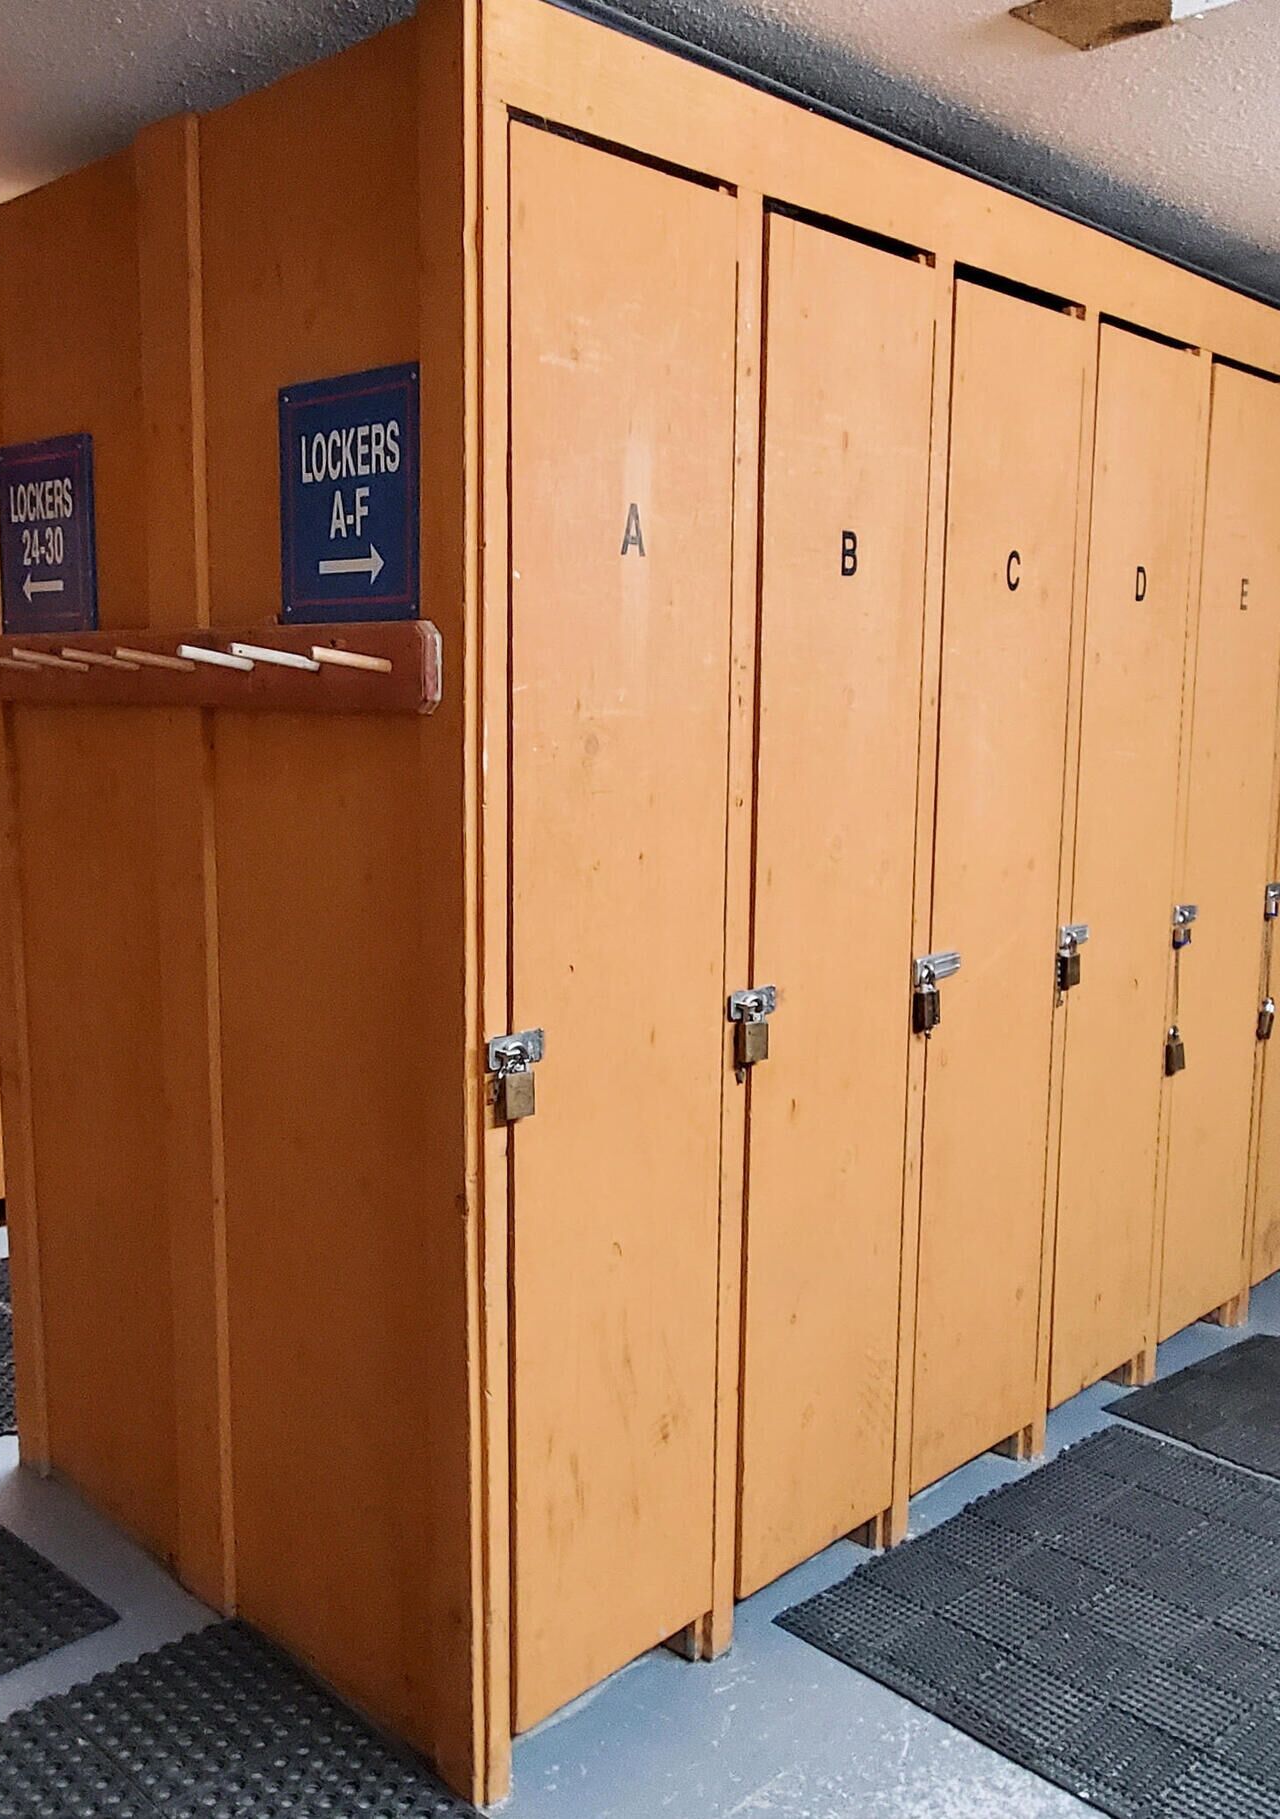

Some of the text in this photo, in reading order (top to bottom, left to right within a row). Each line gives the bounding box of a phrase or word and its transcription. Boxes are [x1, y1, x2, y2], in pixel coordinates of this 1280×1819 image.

[301, 420, 400, 483] LOCKERS
[10, 477, 73, 523] LOCKERS
[329, 486, 370, 539] A-F
[22, 526, 64, 566] 24-30
[620, 503, 646, 557] A
[841, 530, 858, 577] B
[1006, 550, 1021, 592] C
[1135, 565, 1147, 602] D
[1239, 578, 1249, 611] E
